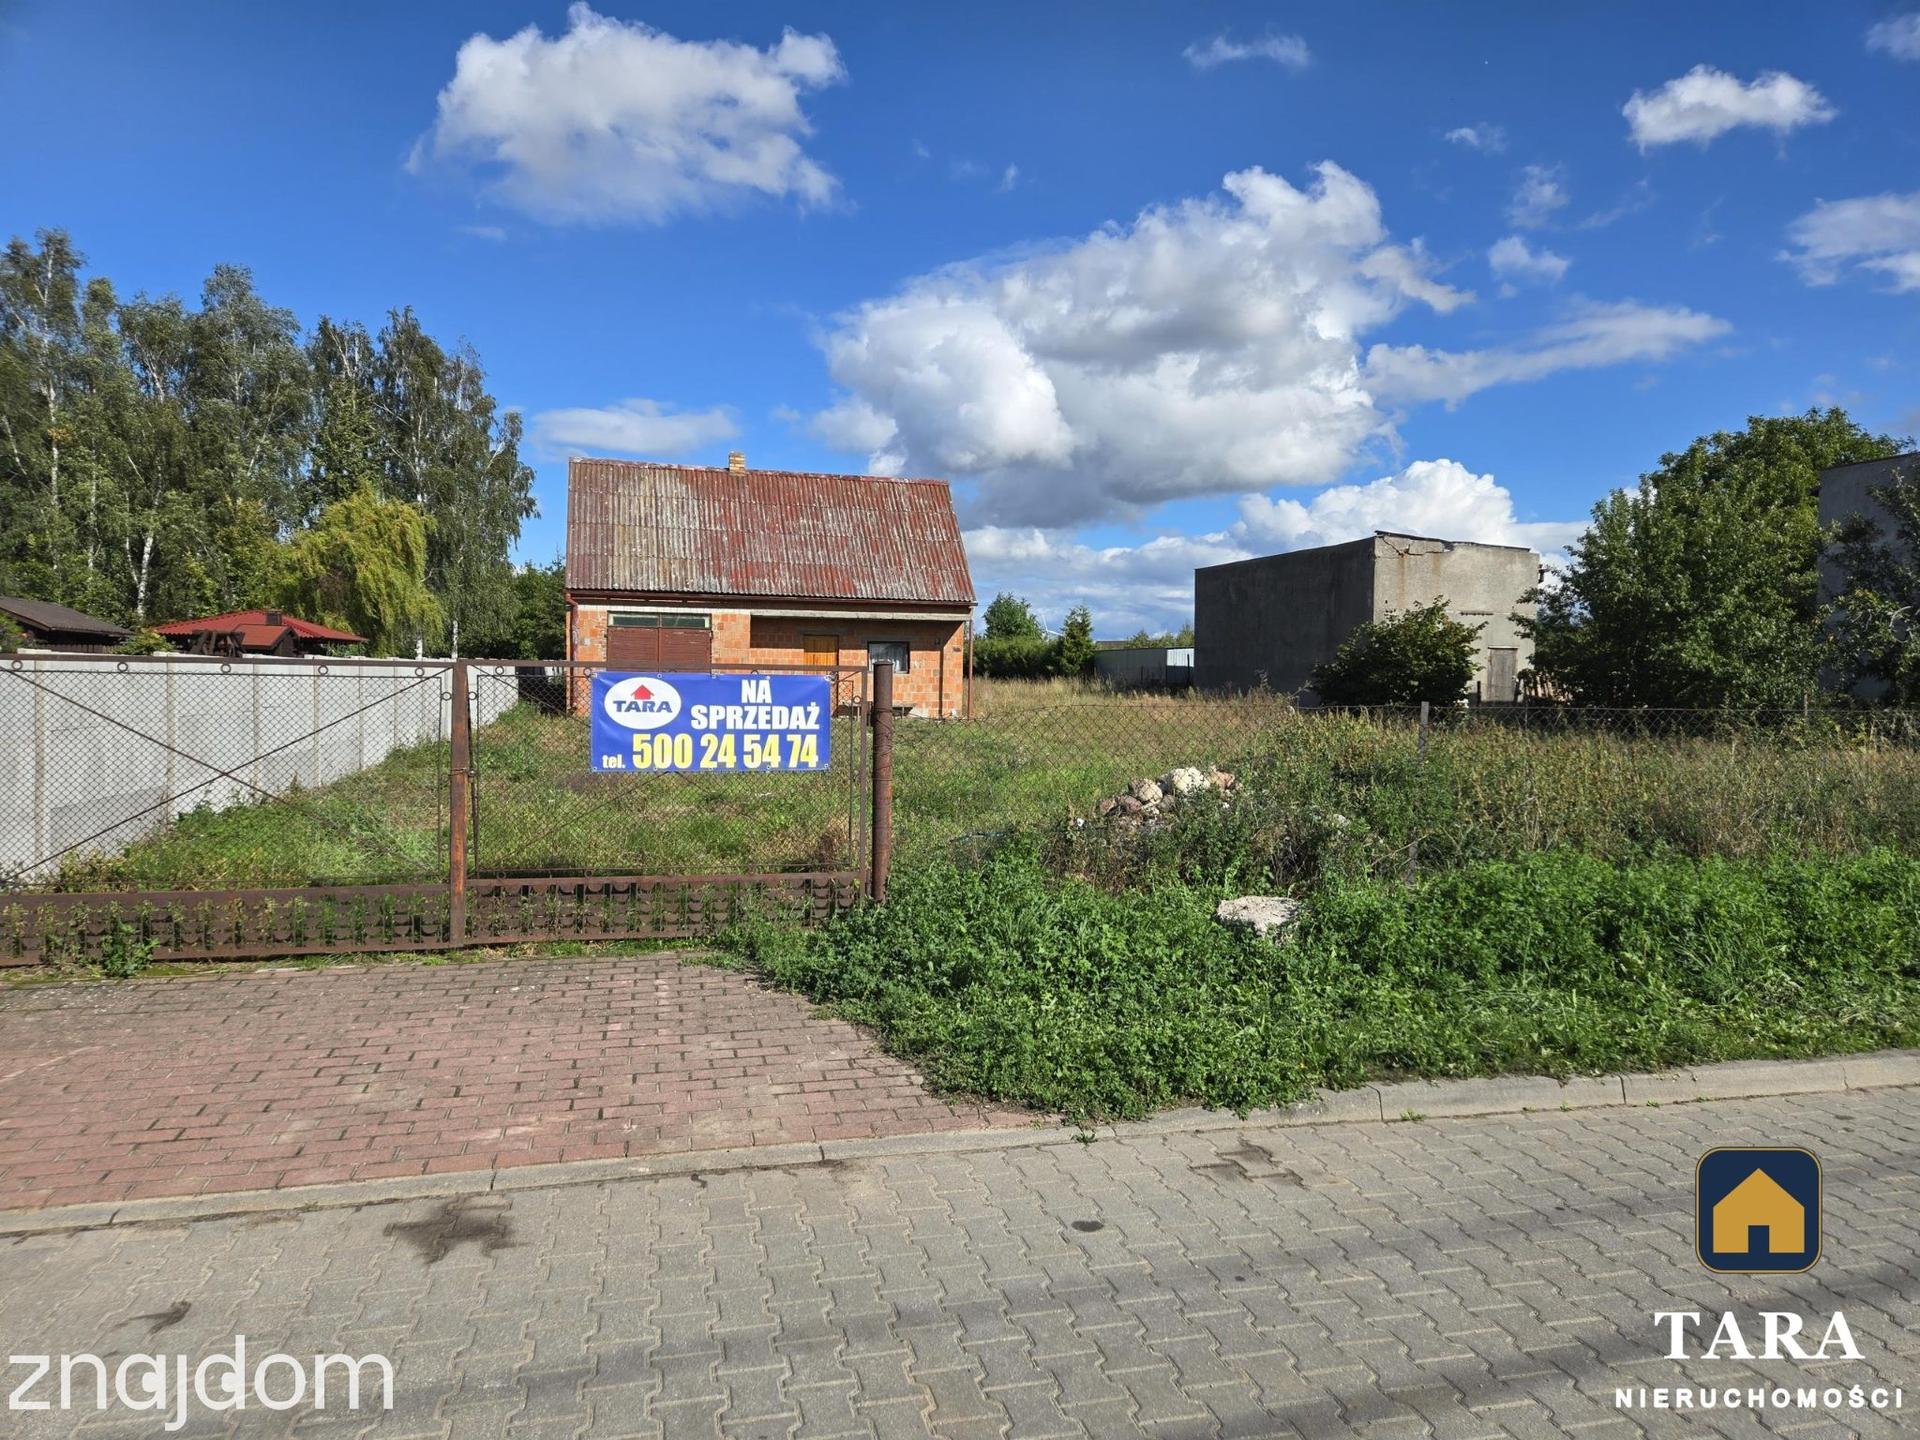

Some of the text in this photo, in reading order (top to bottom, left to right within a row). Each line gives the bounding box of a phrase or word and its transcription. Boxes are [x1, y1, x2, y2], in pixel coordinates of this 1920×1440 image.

[741, 679, 772, 704] NA
[612, 700, 673, 713] TARA
[690, 702, 820, 730] SPRZEDAŻ
[602, 733, 818, 769] tel. 500 24 54 74
